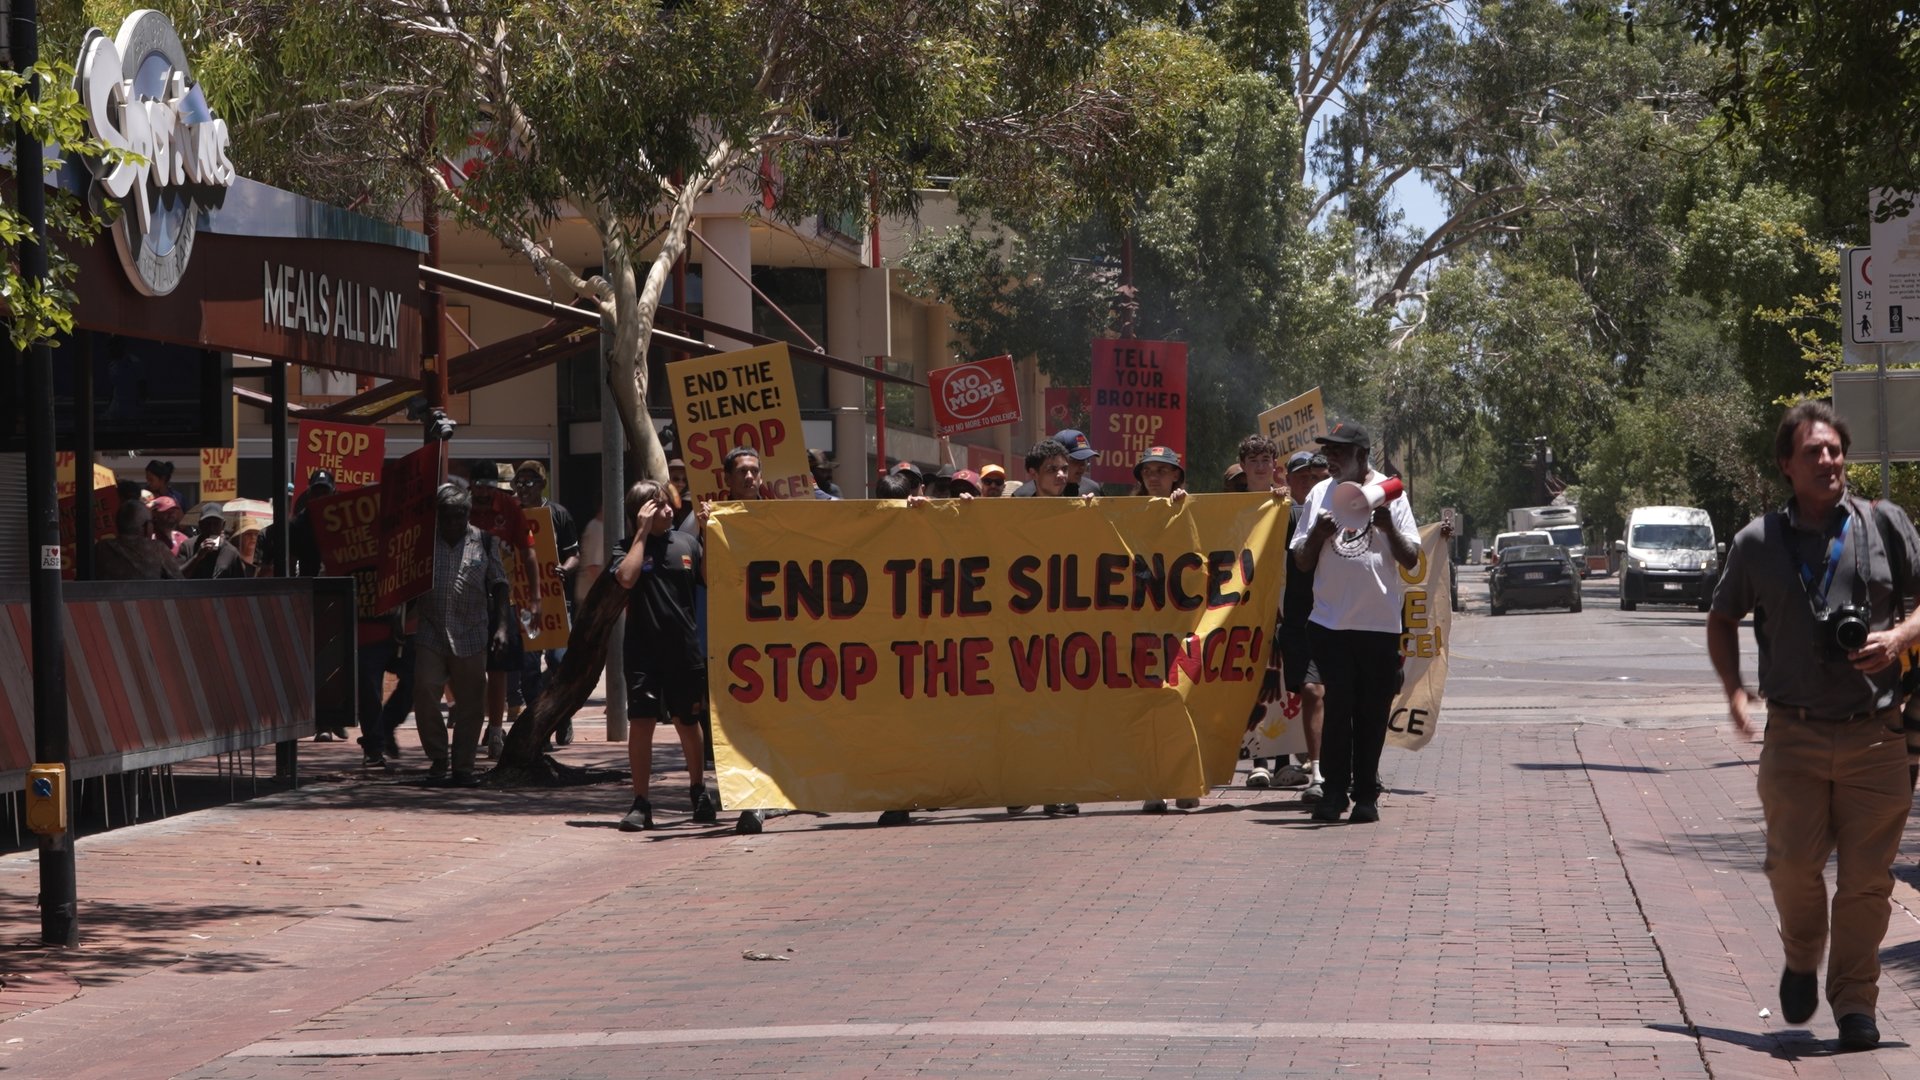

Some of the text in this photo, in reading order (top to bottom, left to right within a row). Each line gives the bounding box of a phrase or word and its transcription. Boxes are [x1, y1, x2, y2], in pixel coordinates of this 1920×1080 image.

[264, 260, 402, 350] MEALS ALL DAY
[1113, 348, 1160, 368] TELL
[683, 361, 774, 397] END THE
[950, 374, 980, 395] NO
[1116, 369, 1163, 388] YOUR
[687, 387, 781, 423] SILENCE!
[948, 378, 1006, 411] MORE
[1097, 389, 1181, 410] BROTHER
[943, 411, 1018, 434] SAY NO MORE TO VIOLENCE
[1108, 413, 1163, 434] STOP
[1269, 403, 1315, 439] END THE
[307, 428, 370, 457] STOP
[687, 418, 786, 470] STOP
[1122, 434, 1156, 451] THE
[203, 448, 233, 465] STOP
[319, 453, 344, 469] THE
[209, 465, 222, 478] THE
[341, 525, 373, 545] THE
[387, 523, 423, 558] STOP
[394, 547, 416, 571] THE
[377, 556, 433, 598] VIOLENCE
[745, 548, 1255, 621] END THE SILENCE!
[728, 625, 1265, 704] STOP THE VIOLENCE!
